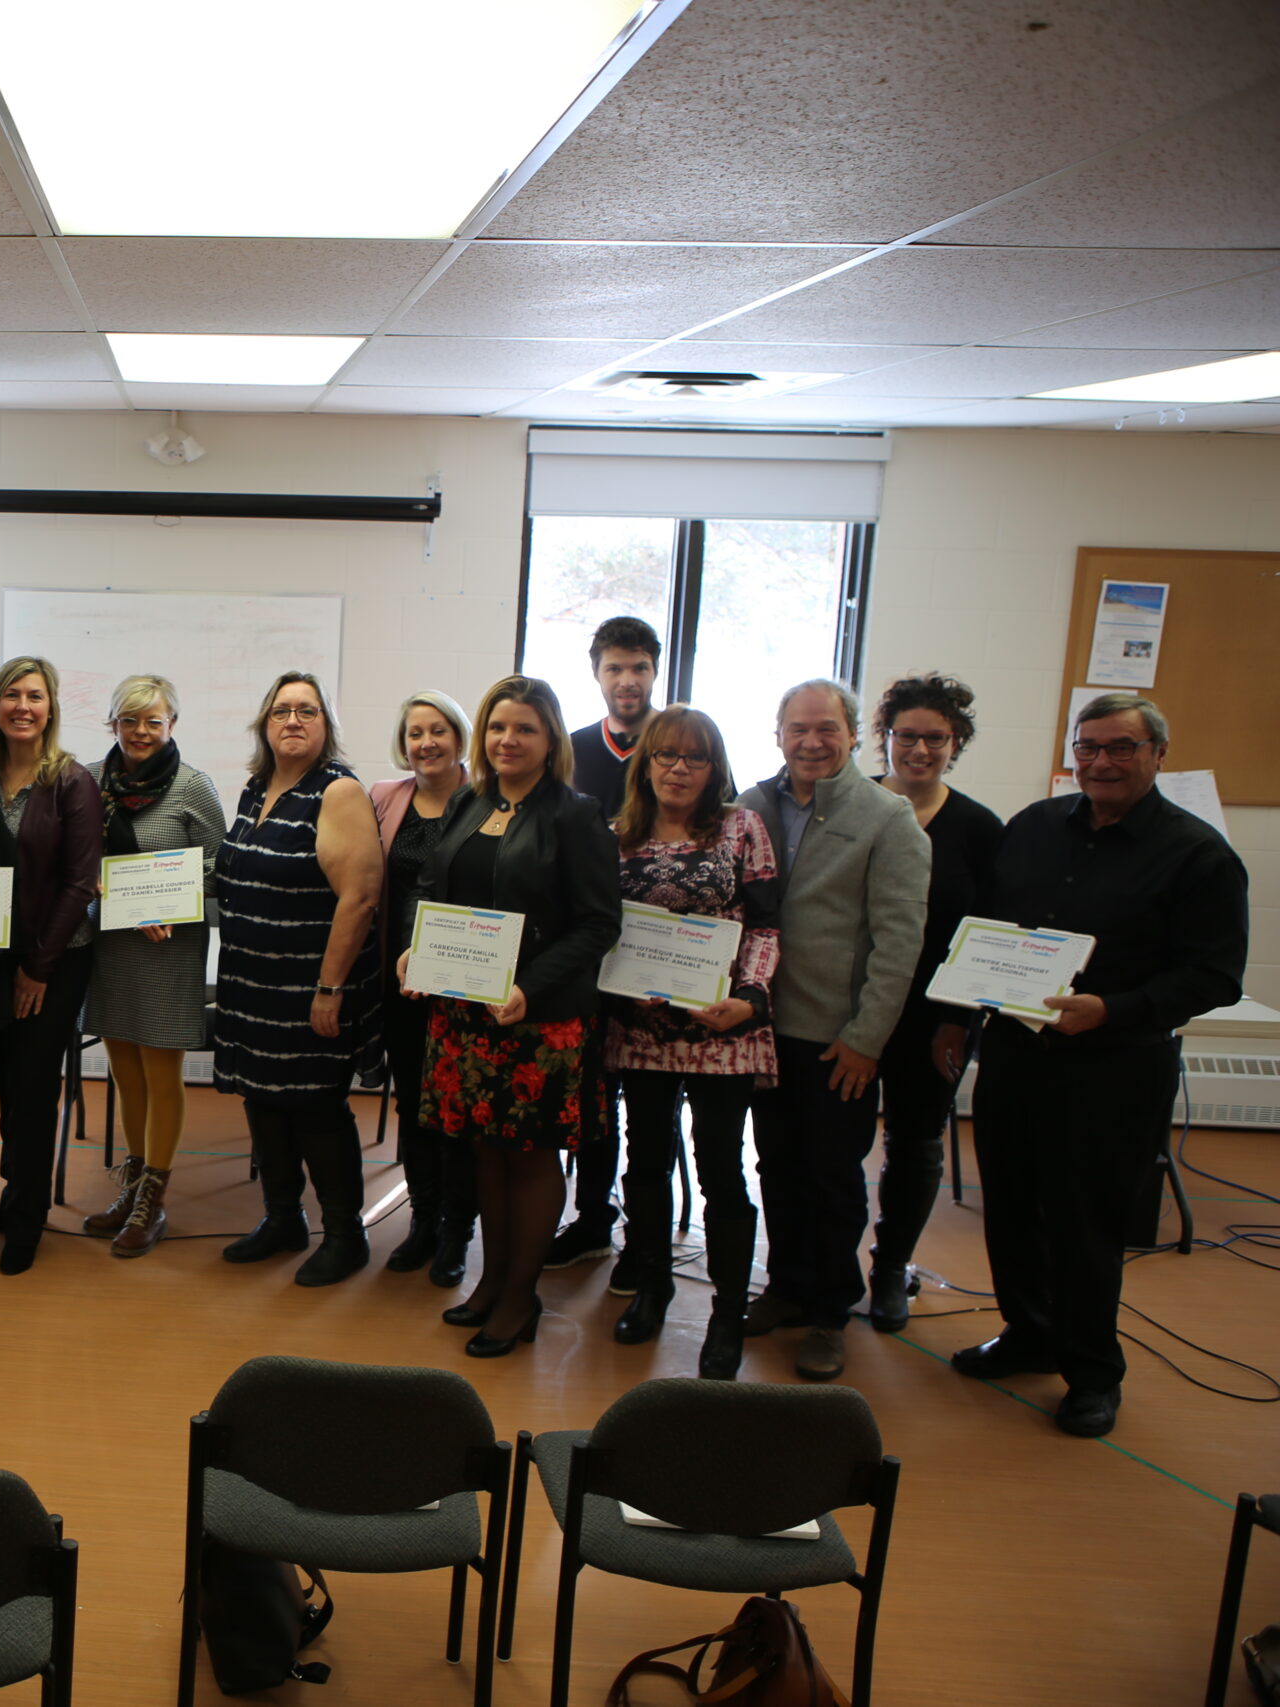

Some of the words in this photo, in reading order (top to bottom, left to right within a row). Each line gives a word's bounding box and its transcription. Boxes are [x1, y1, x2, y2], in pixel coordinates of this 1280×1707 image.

[429, 943, 467, 953] CARREFOUR
[468, 948, 498, 958] FAMILIAL
[971, 956, 1000, 966] CENTRE
